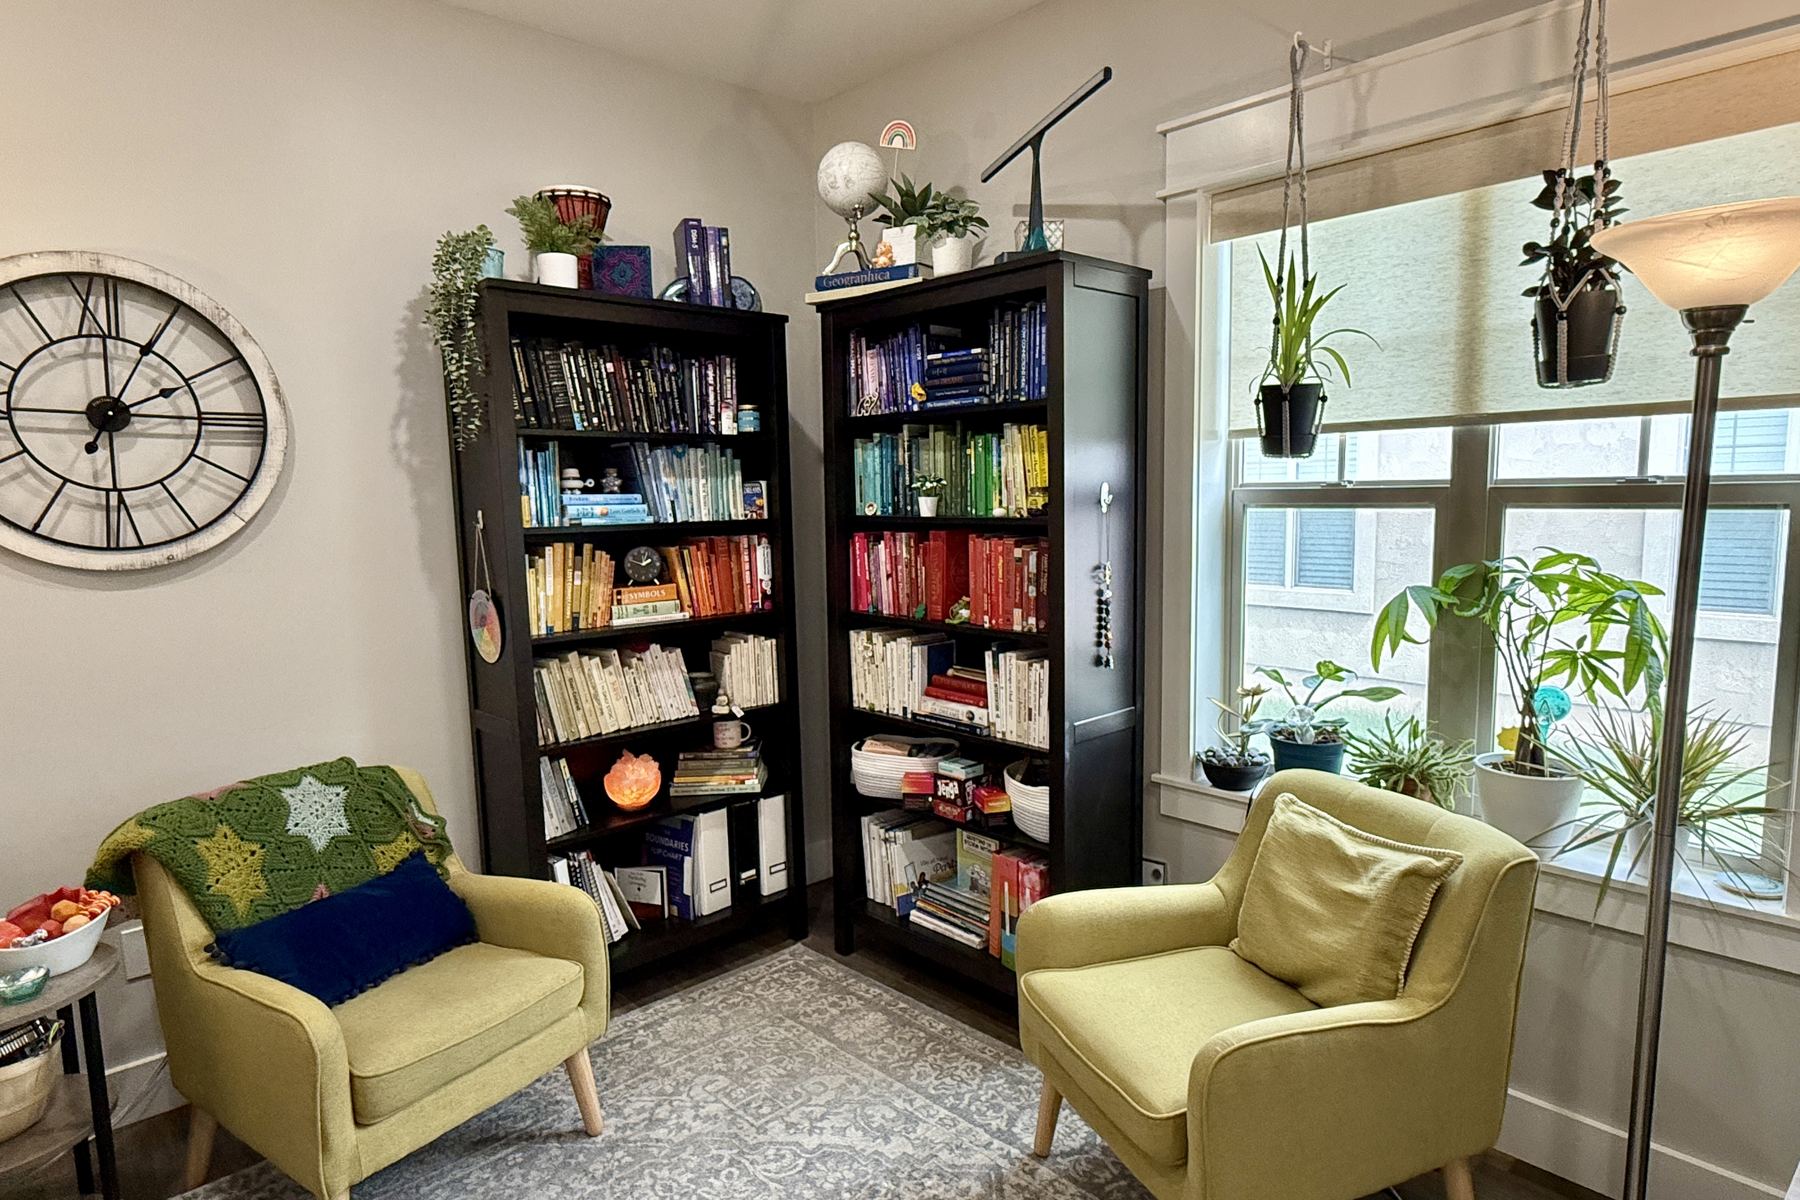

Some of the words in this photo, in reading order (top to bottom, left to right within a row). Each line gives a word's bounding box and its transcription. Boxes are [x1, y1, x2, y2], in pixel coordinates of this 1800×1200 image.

[823, 270, 890, 288] Geographica
[628, 588, 666, 600] SYMBOLS
[937, 779, 960, 799] Jenga
